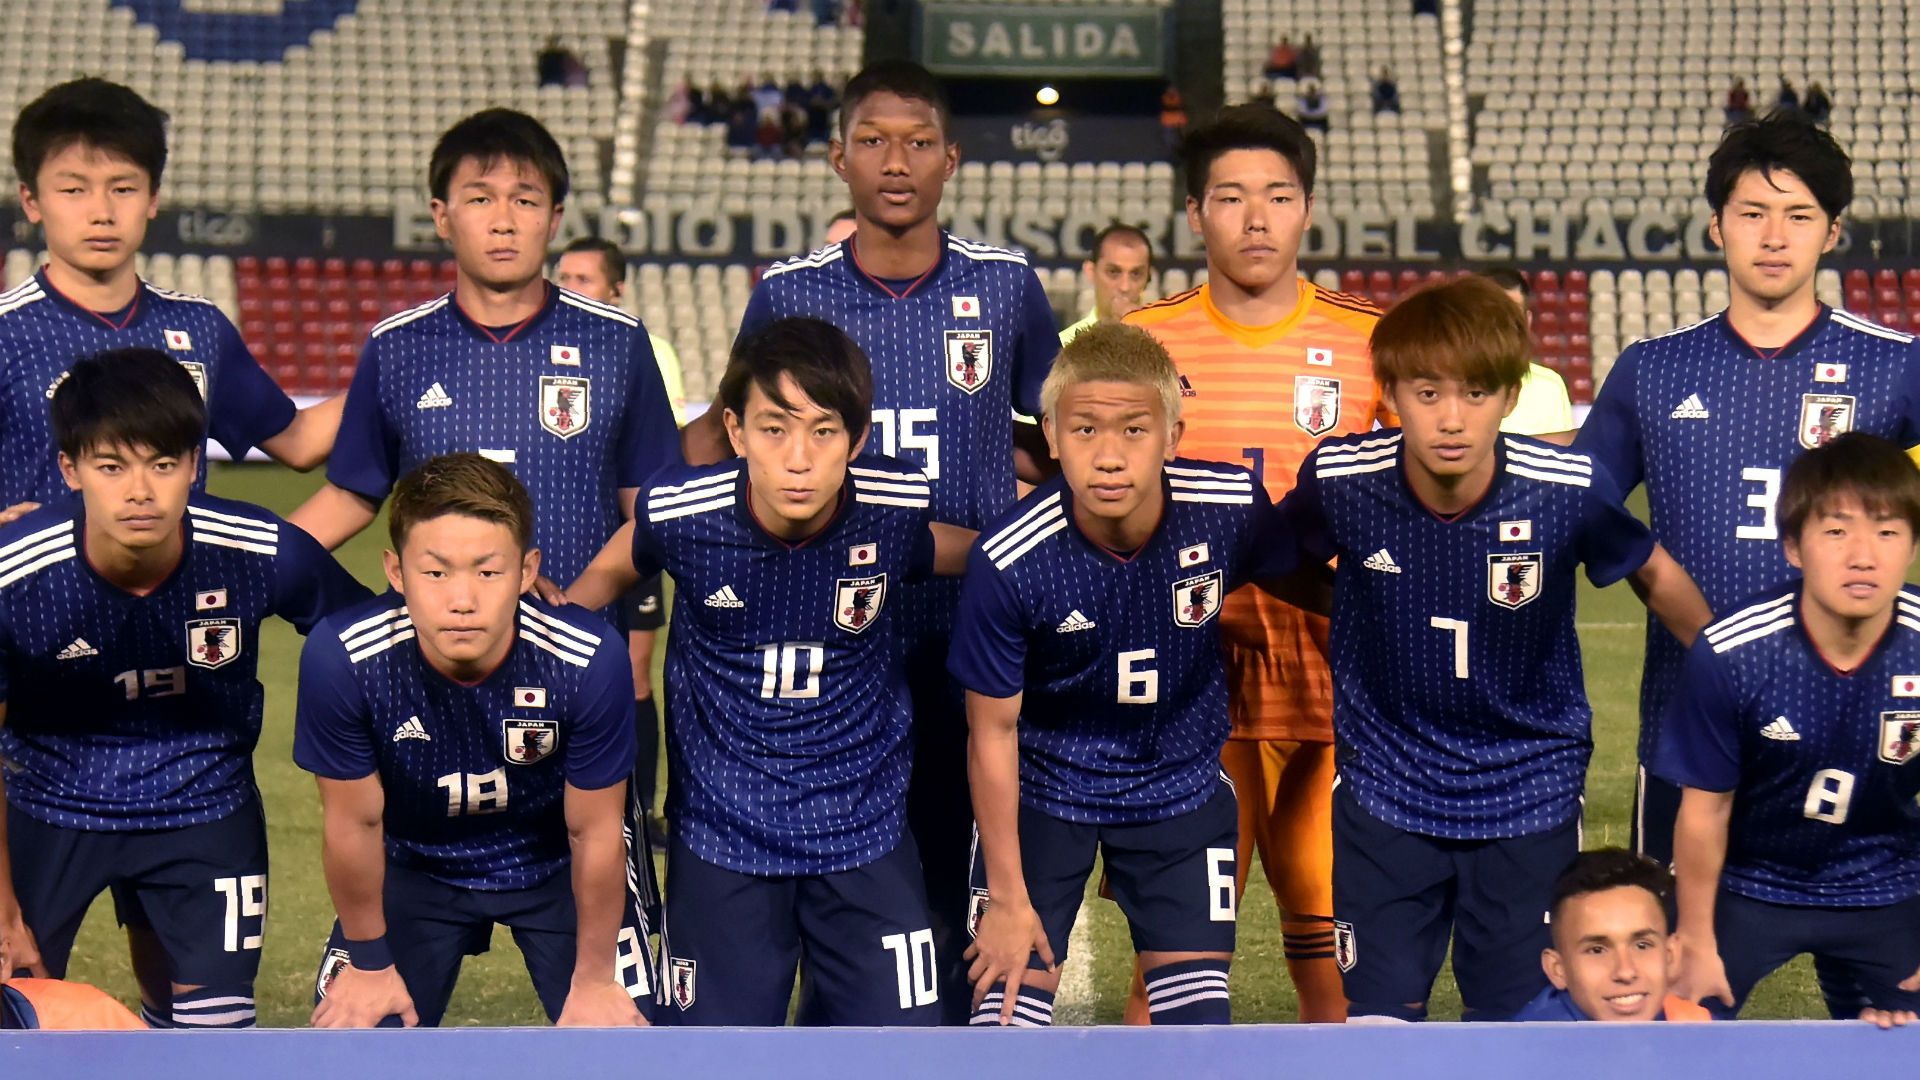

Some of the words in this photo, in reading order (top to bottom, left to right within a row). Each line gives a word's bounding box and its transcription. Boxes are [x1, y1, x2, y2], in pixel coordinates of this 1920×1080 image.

[948, 21, 1139, 58] SALIDA
[1010, 118, 1070, 162] tigo
[393, 203, 734, 256] EADIO
[1297, 206, 1441, 260] DEL
[552, 378, 578, 386] JAPAN
[871, 408, 939, 480] 15
[1736, 467, 1781, 540] 3
[850, 579, 876, 587] JAPAN
[1185, 575, 1210, 587] JAPAN
[1363, 560, 1402, 574] adidas
[704, 598, 745, 608] adidas
[1056, 621, 1096, 633] adidas
[1430, 616, 1469, 679] 7
[56, 648, 99, 660] adidas
[755, 641, 824, 699] 10
[1117, 649, 1159, 704] 6
[114, 665, 187, 701] 19
[393, 730, 431, 742] adidas
[437, 767, 509, 817] 18
[1804, 768, 1856, 824] 8
[1206, 847, 1236, 921] 6
[214, 874, 267, 952] 19
[881, 928, 939, 1009] 10
